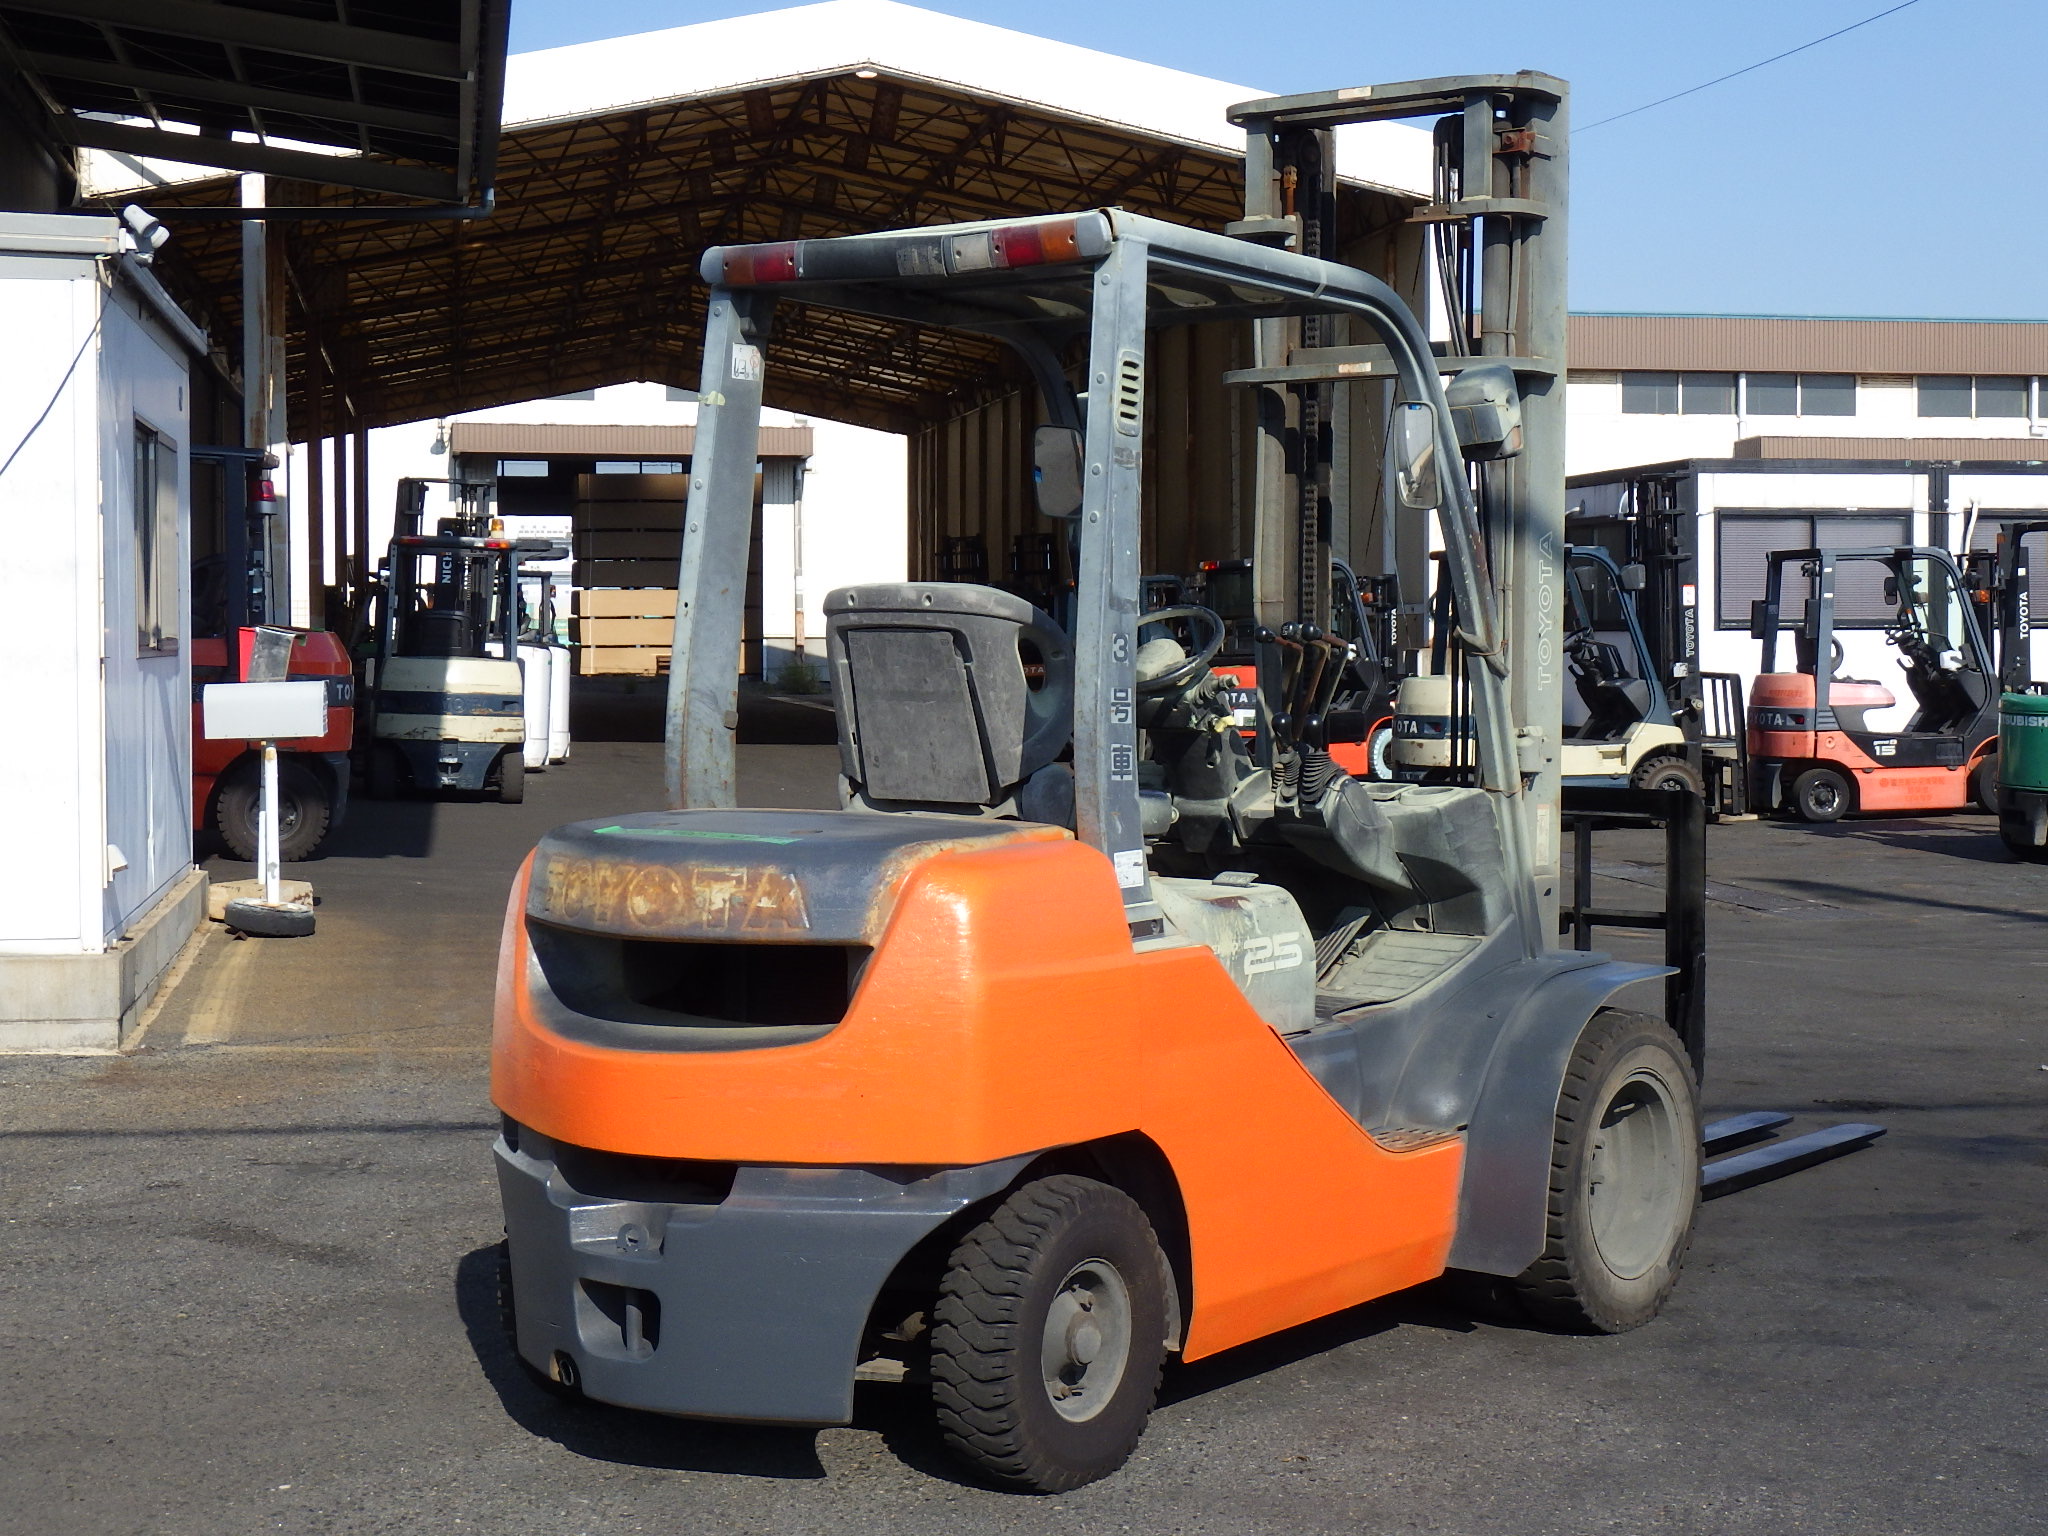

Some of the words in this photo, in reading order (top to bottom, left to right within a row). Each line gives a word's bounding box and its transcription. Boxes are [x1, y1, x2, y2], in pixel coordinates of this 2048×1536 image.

[1538, 531, 1553, 691] TOYOTA
[1685, 608, 1695, 657] TOYOTA
[2020, 591, 2029, 640] TOYOTA
[1874, 745, 1896, 756] 15
[547, 855, 812, 932] TOYOTA
[1244, 932, 1302, 975] 25
